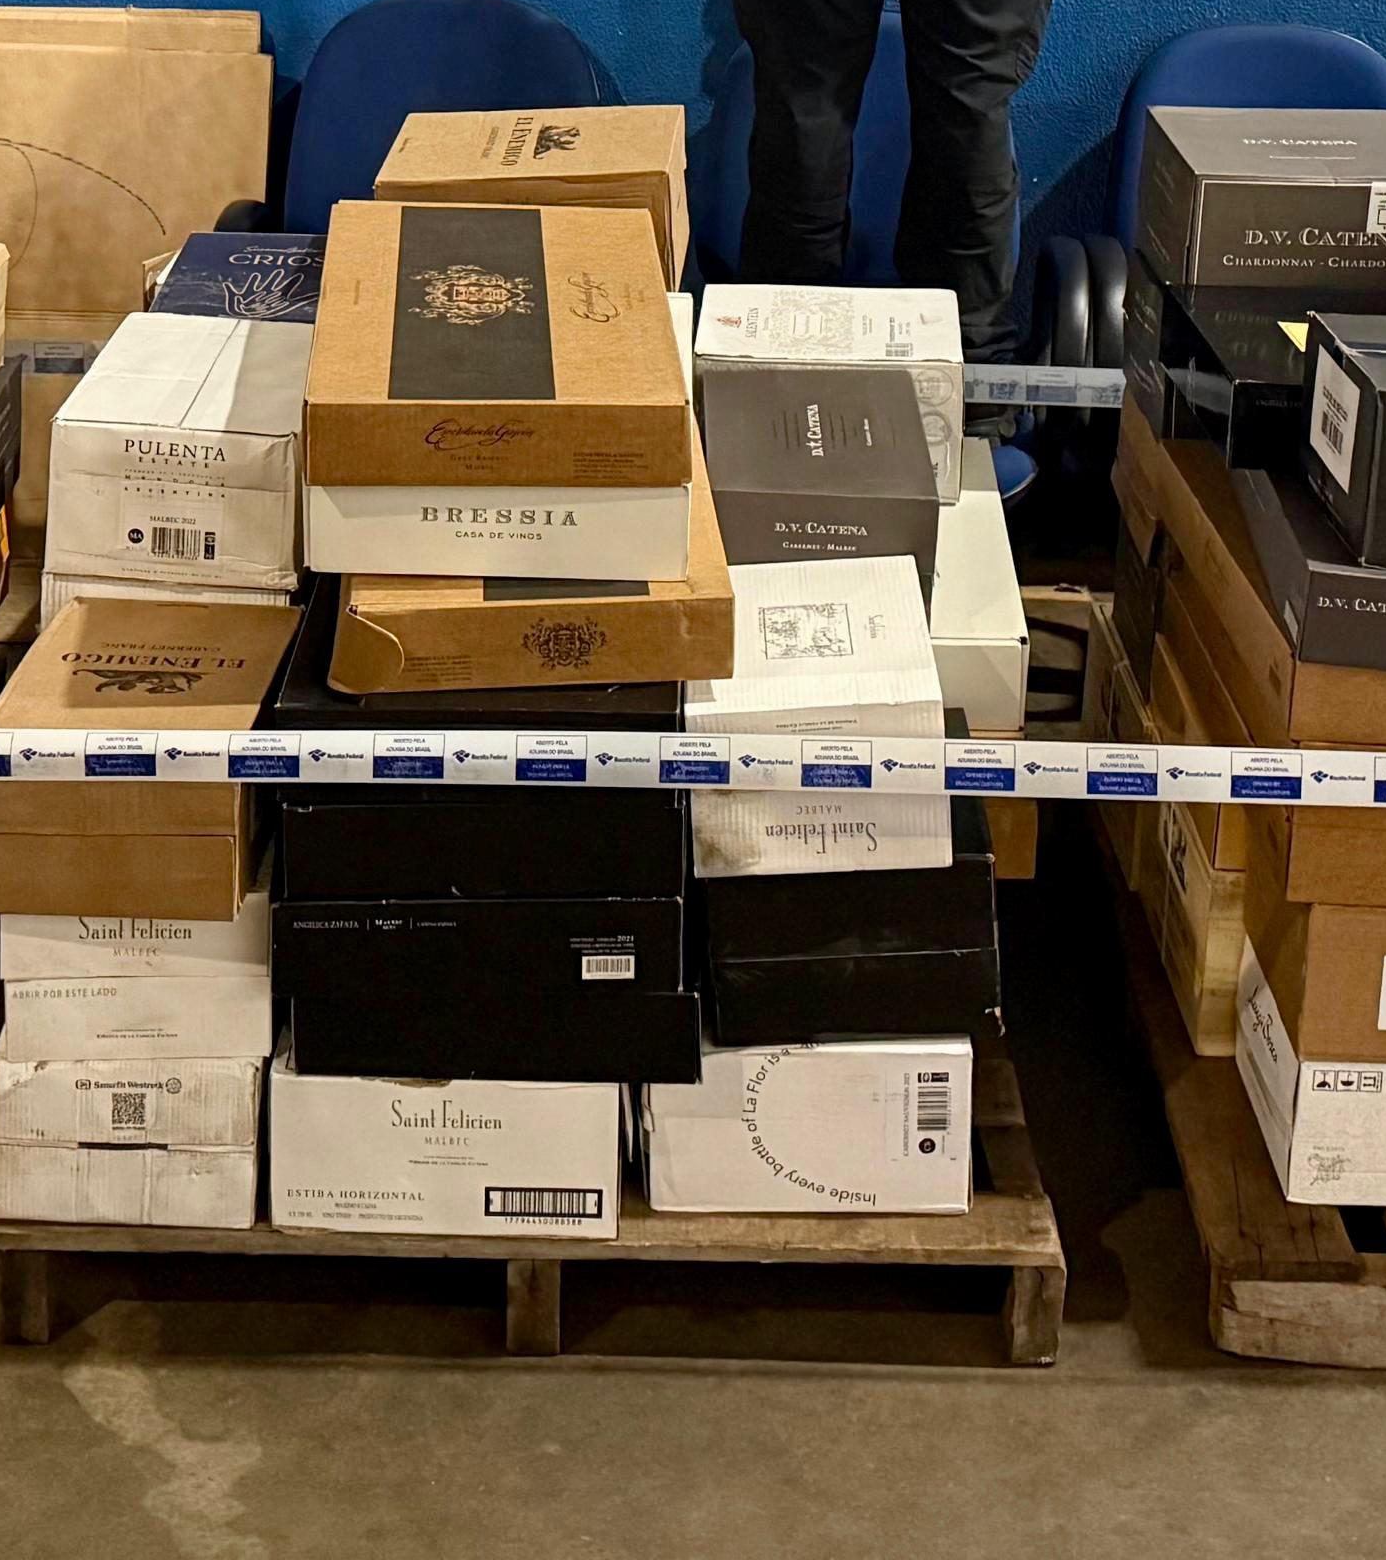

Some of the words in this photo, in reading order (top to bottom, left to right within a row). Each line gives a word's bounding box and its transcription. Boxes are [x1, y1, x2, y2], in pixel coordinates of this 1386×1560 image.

[501, 128, 532, 167] ENEMIGO
[1245, 229, 1291, 246] D.V.
[1222, 255, 1316, 268] CHARDONNAY
[124, 439, 226, 462] PULENTA
[138, 456, 210, 469] ESTATE
[420, 506, 579, 527] BRESSIA
[774, 522, 803, 533] D.V.
[805, 522, 868, 536] CATENA
[1317, 595, 1349, 609] D.V.
[61, 652, 201, 669] ENEMIGO
[211, 658, 247, 670] EL
[796, 805, 842, 815] MALBEC
[765, 824, 826, 854] Felicien
[831, 822, 878, 851] Saint
[79, 917, 124, 940] Saint
[131, 918, 193, 941] Felicien
[12, 989, 41, 999] ABRIR
[43, 989, 63, 998] POR
[65, 988, 87, 998] ESTE
[91, 987, 117, 997] LADO
[767, 1054, 781, 1066] is
[747, 1066, 769, 1094] Flor
[743, 1097, 757, 1114] La
[391, 1100, 436, 1129] Saint
[442, 1100, 503, 1131] Felicien
[741, 1117, 757, 1133] of
[424, 1137, 470, 1146] MALBEC
[751, 1135, 784, 1176] bottle
[783, 1170, 825, 1193] every
[339, 1190, 425, 1202] HORIZONTAL
[830, 1188, 876, 1206] Inside
